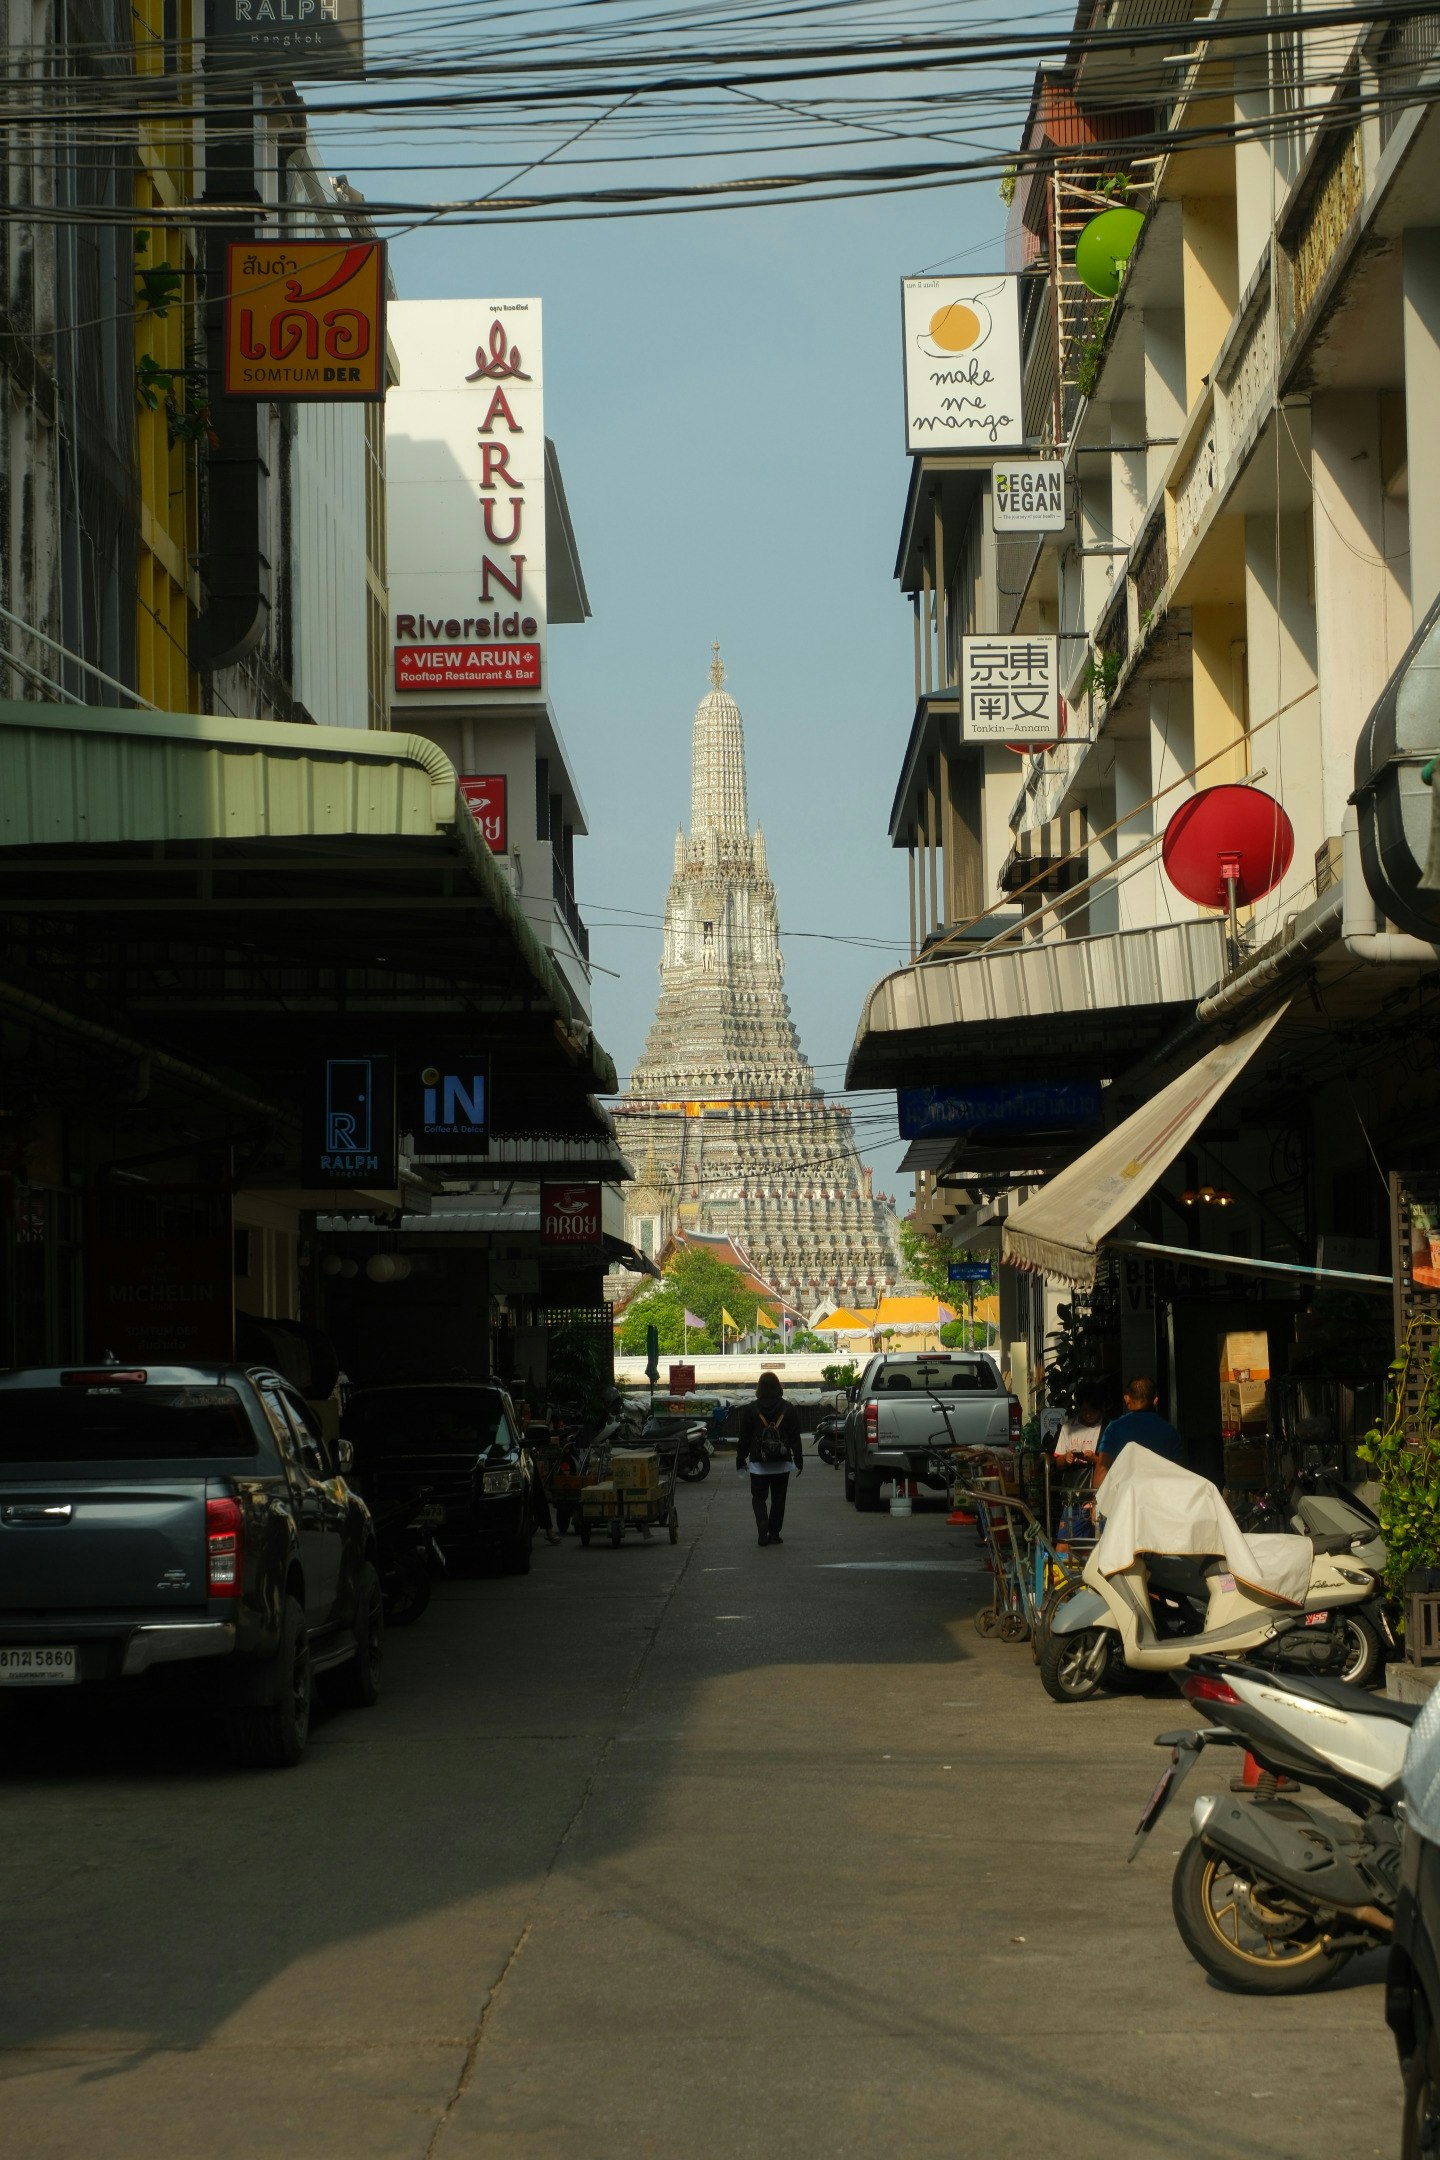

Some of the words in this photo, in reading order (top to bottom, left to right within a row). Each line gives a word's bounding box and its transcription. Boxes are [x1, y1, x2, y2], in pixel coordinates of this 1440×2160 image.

[235, 0, 338, 20] RALPH
[251, 32, 322, 46] Bangkok
[243, 255, 297, 275] ส้มตำ
[240, 277, 371, 360] เด้อ
[243, 368, 319, 382] SOMTUM
[323, 367, 361, 382] DER
[929, 358, 995, 386] make
[940, 396, 987, 411] me
[912, 415, 1015, 442] mango
[996, 473, 1061, 493] BEGAN
[477, 385, 527, 602] ARUN
[996, 493, 1062, 512] VEGAN
[396, 611, 538, 639] Riverside
[413, 652, 462, 669] VIEW
[466, 650, 521, 667] ARUN
[400, 671, 443, 682] Rooftop
[444, 670, 503, 681] Restaurant
[504, 669, 513, 680] &
[515, 669, 535, 680] Bar
[424, 1125, 451, 1133] Coffee
[452, 1125, 459, 1133] &
[460, 1125, 484, 1133] Dolce
[320, 1155, 379, 1169] RALPH
[546, 1215, 597, 1235] AROY
[108, 1283, 215, 1302] MICHELIN
[35, 1650, 73, 1666] 5860
